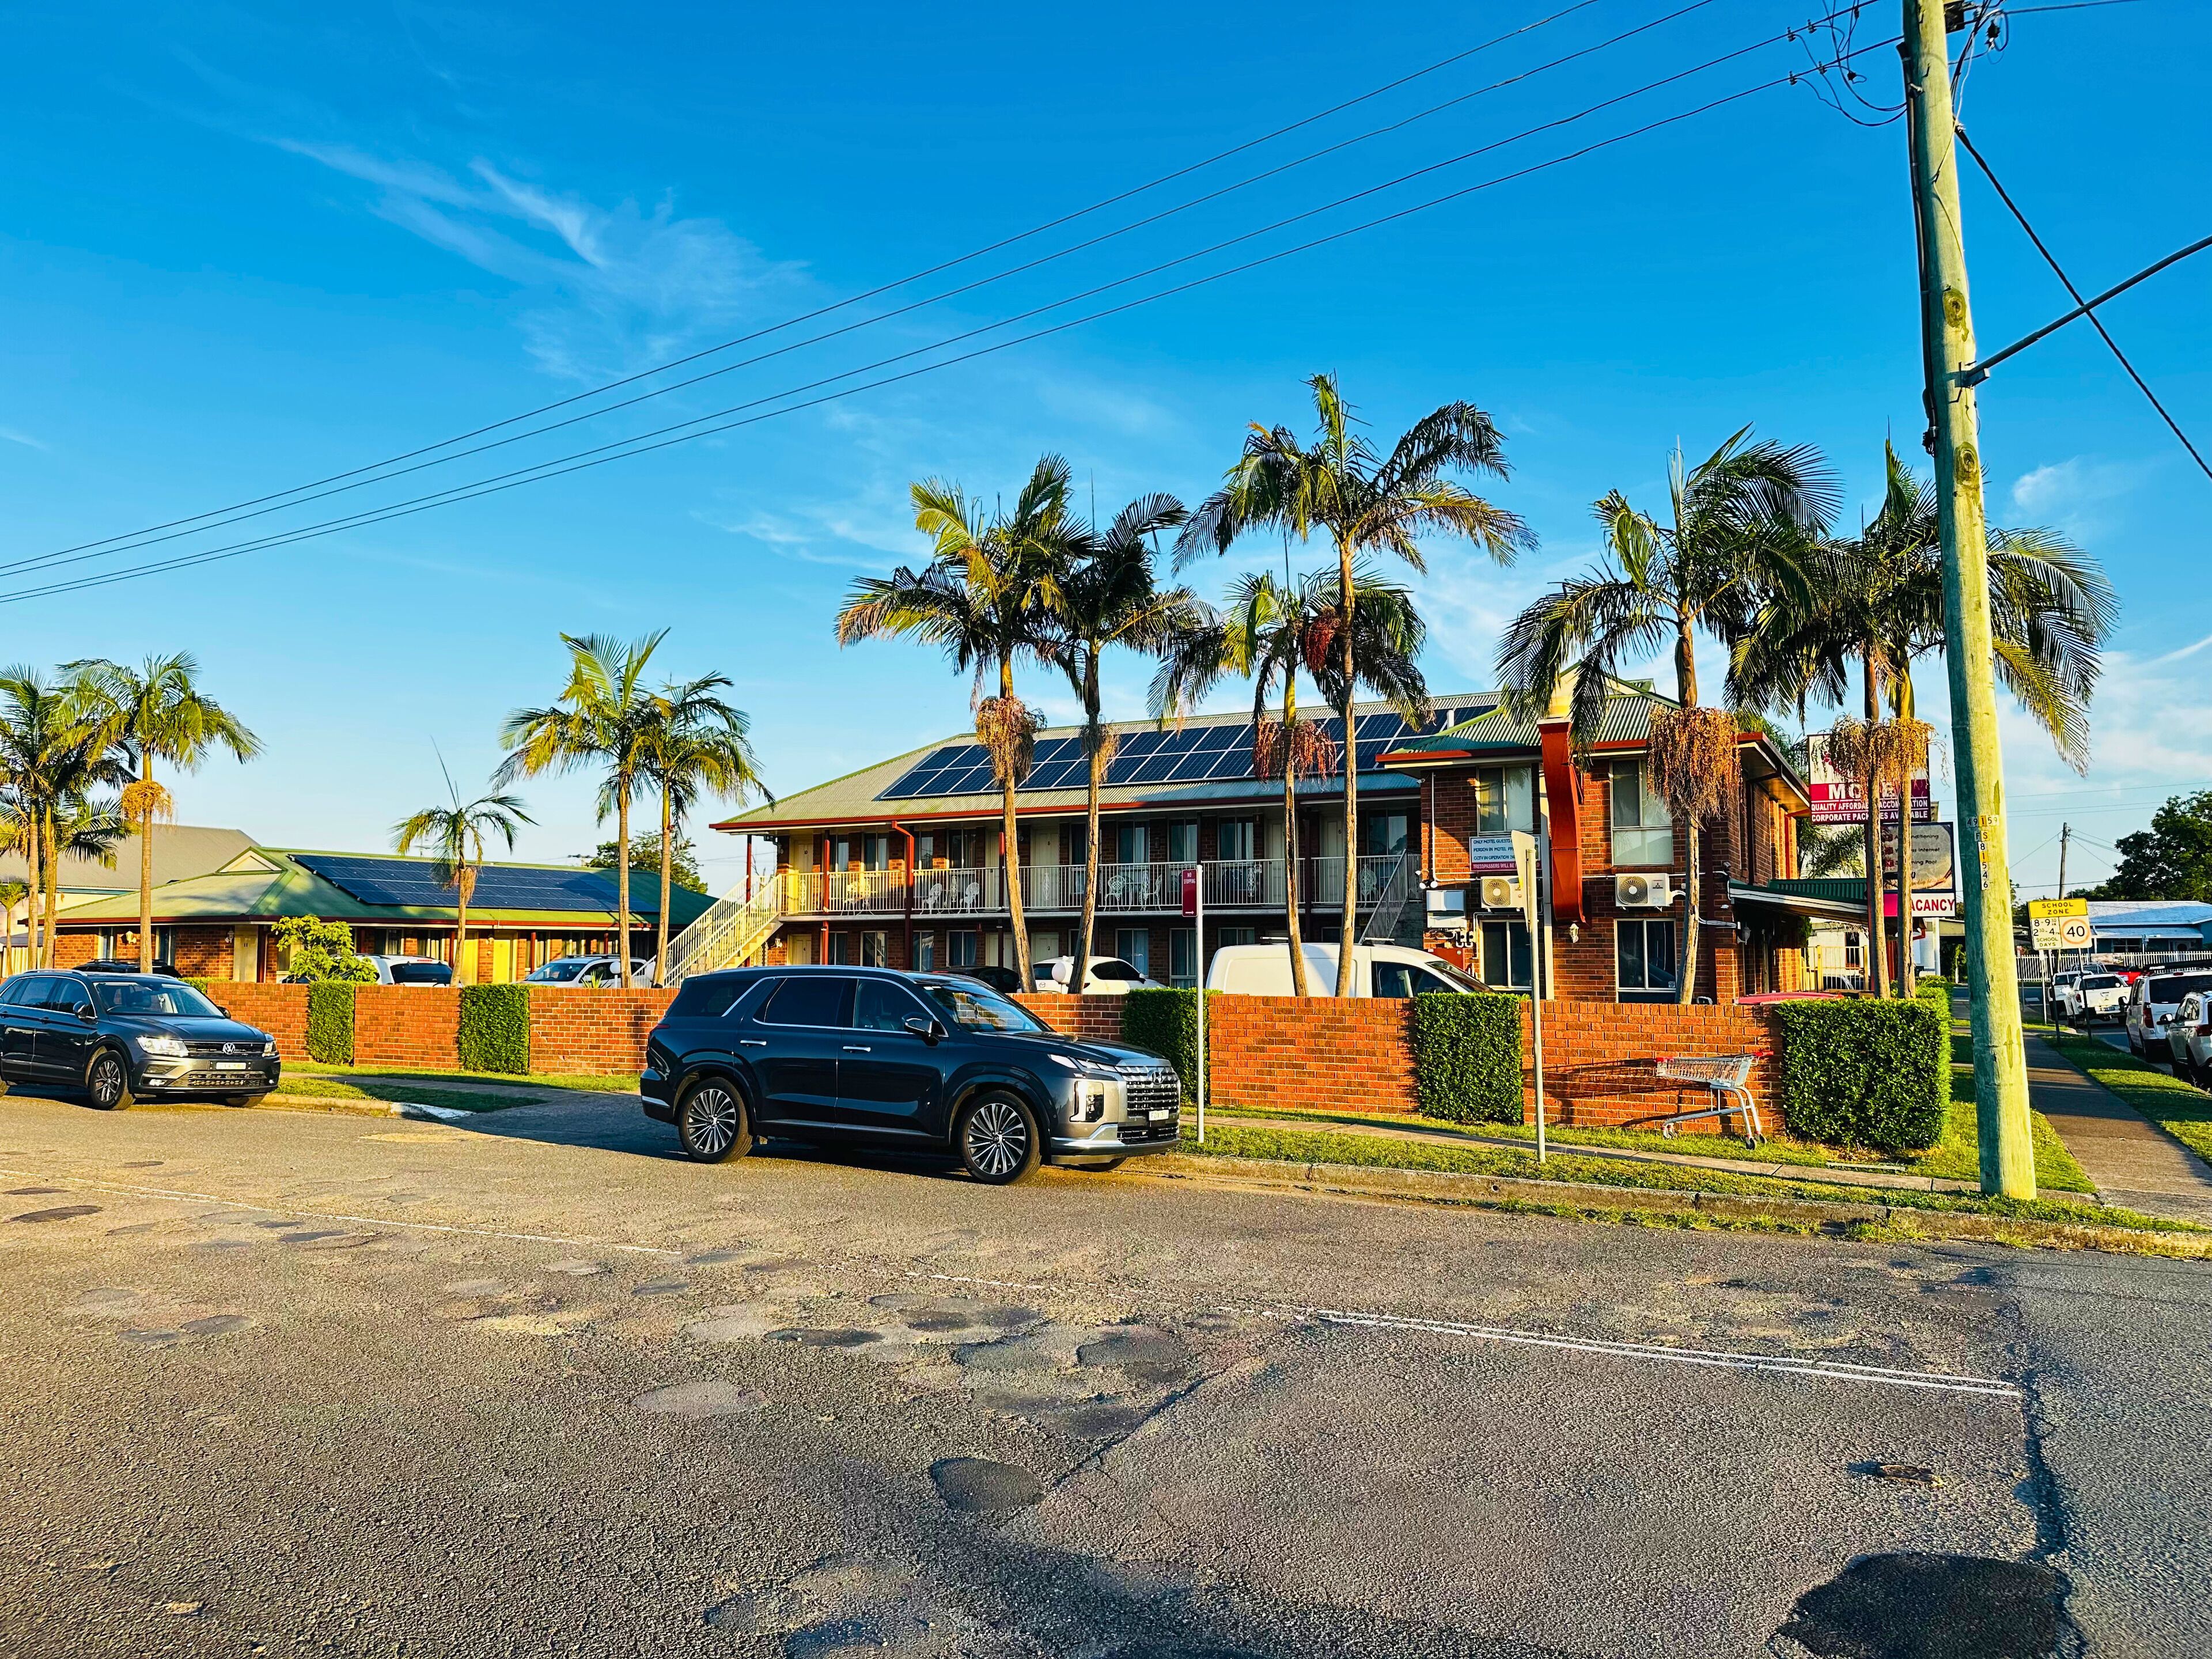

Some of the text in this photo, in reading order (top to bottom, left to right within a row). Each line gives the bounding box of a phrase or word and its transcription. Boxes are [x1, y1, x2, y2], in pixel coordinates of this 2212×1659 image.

[1811, 803, 1836, 811] QUALITY
[1812, 813, 1851, 822] CORPORATE
[1890, 810, 1928, 819] AVABLE
[1967, 817, 1998, 825] 49159
[1911, 899, 1955, 911] ACANCY
[2066, 926, 2085, 937] 40
